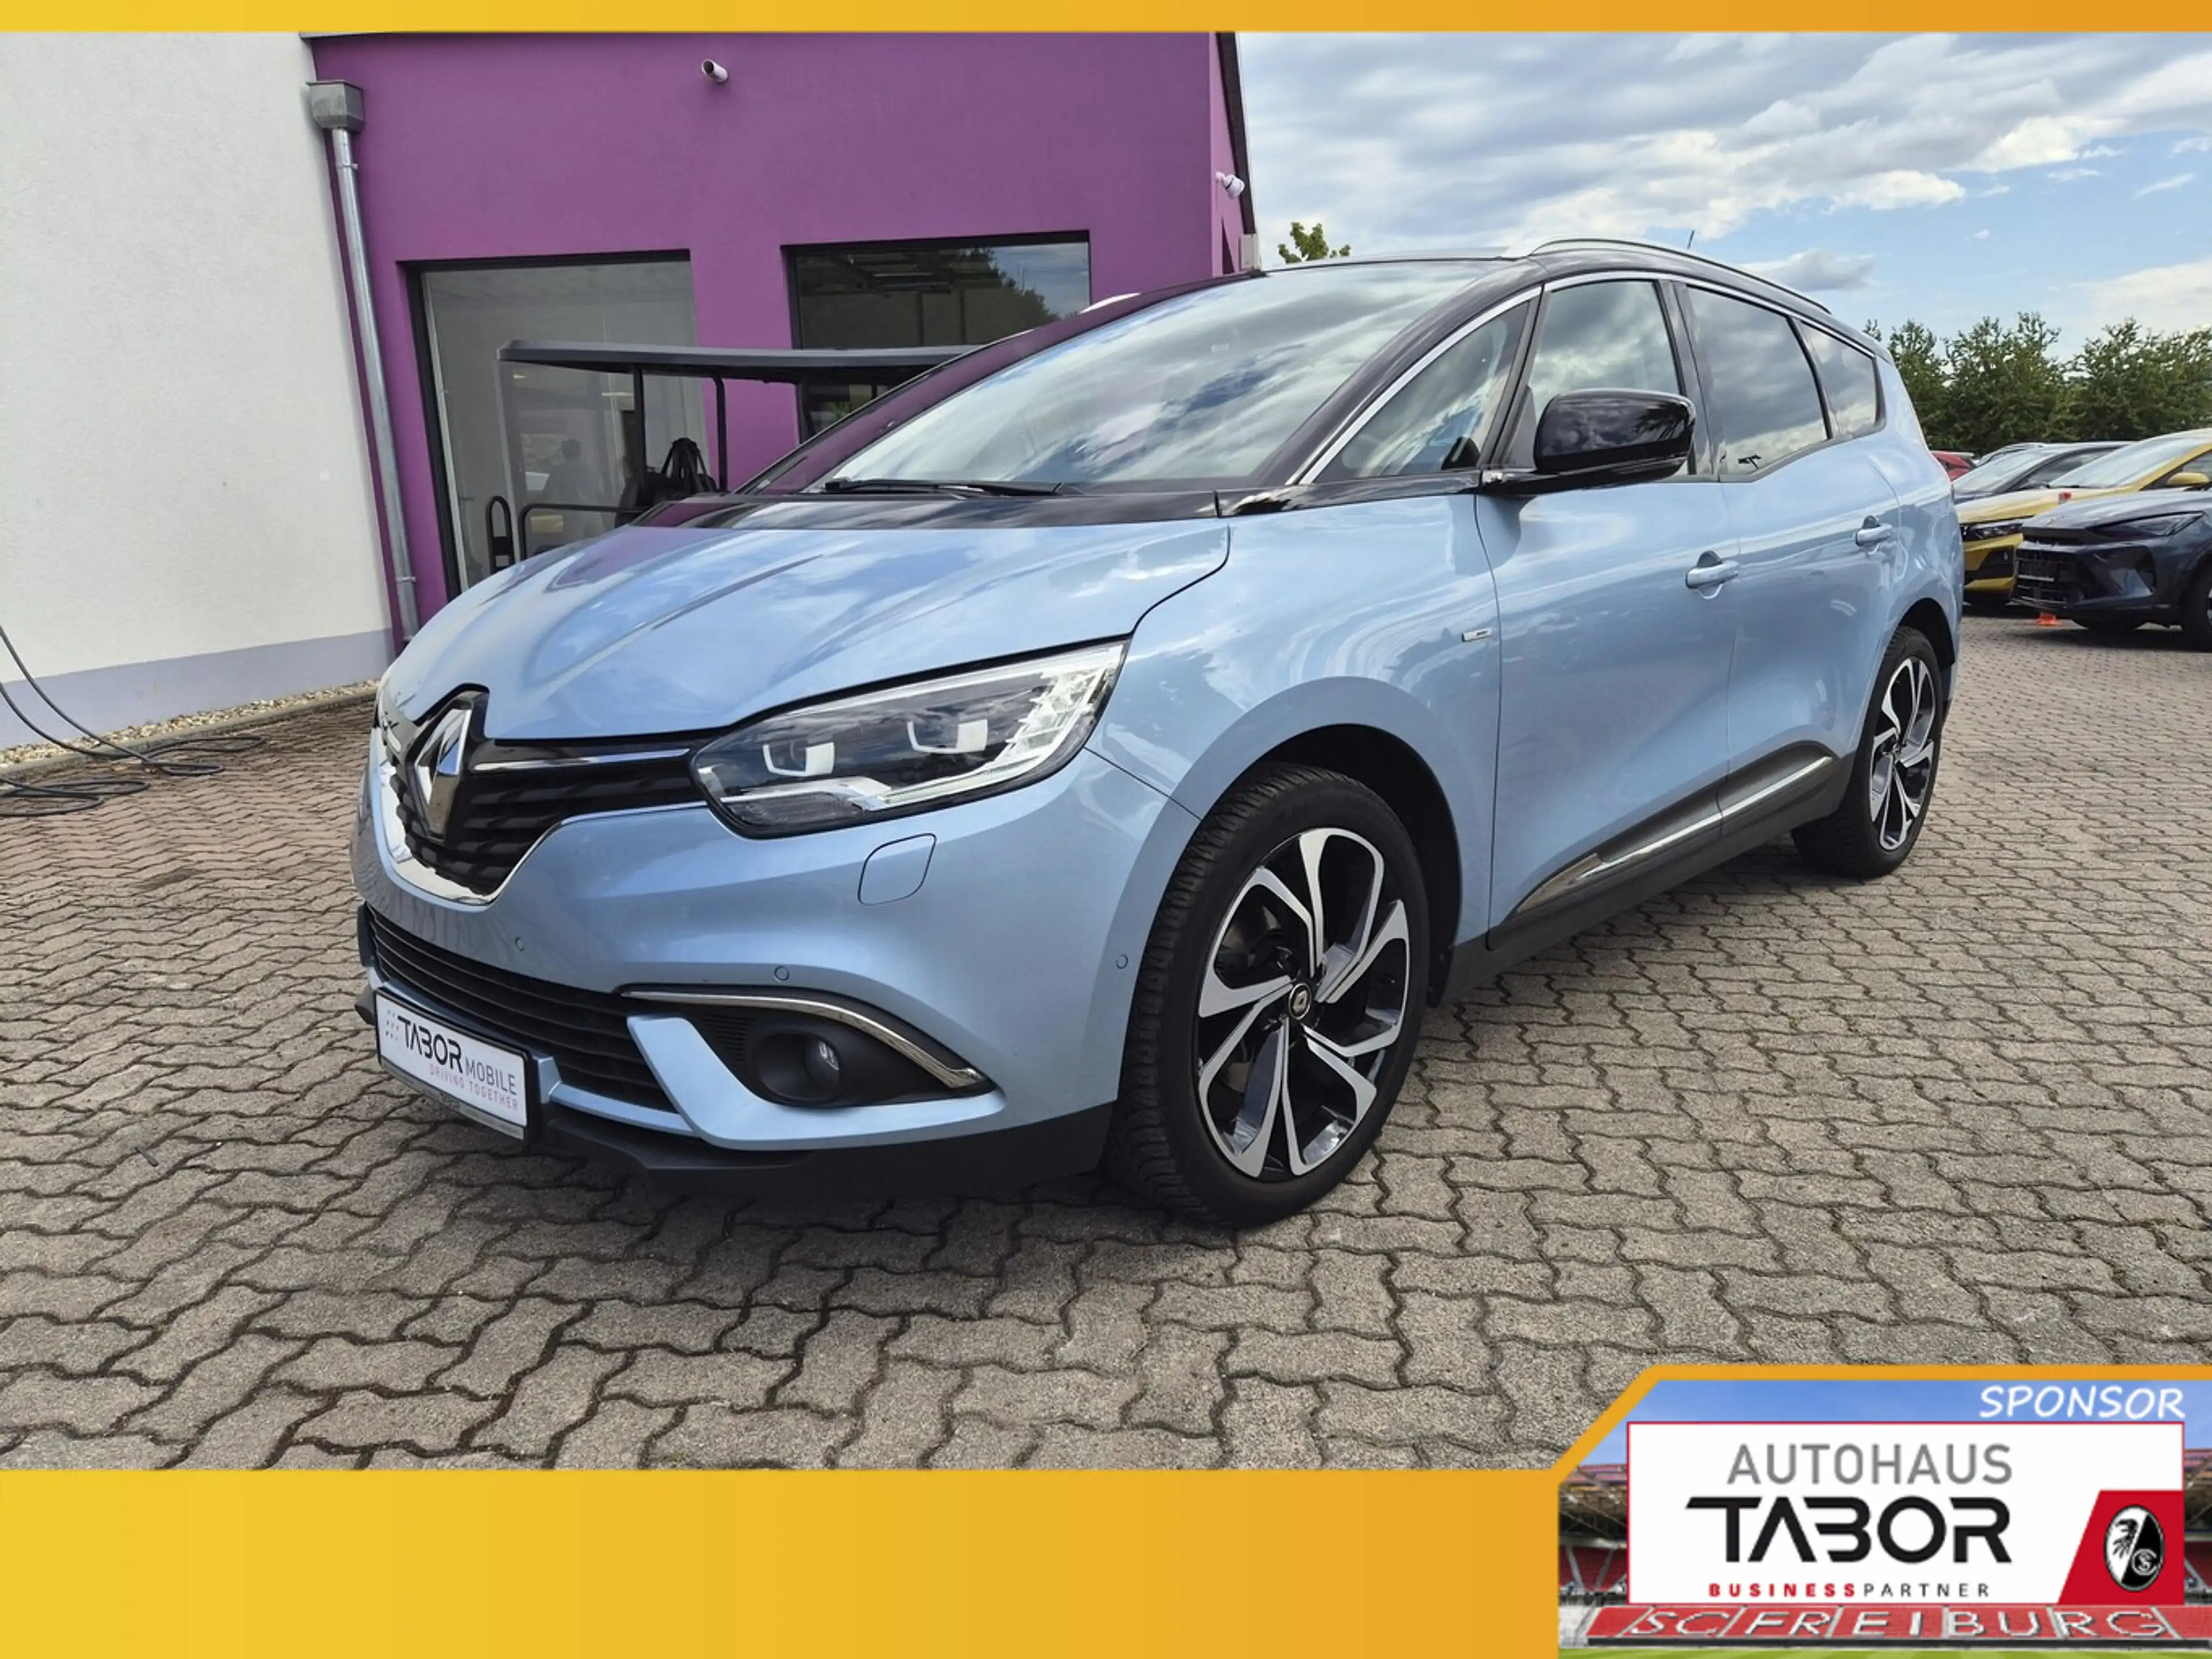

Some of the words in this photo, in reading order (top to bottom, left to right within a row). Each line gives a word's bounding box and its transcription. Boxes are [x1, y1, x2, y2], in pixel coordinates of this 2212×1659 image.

[397, 1016, 463, 1073] TABOR
[464, 1056, 517, 1096] MOBILE
[468, 1081, 518, 1112] TOGETHER
